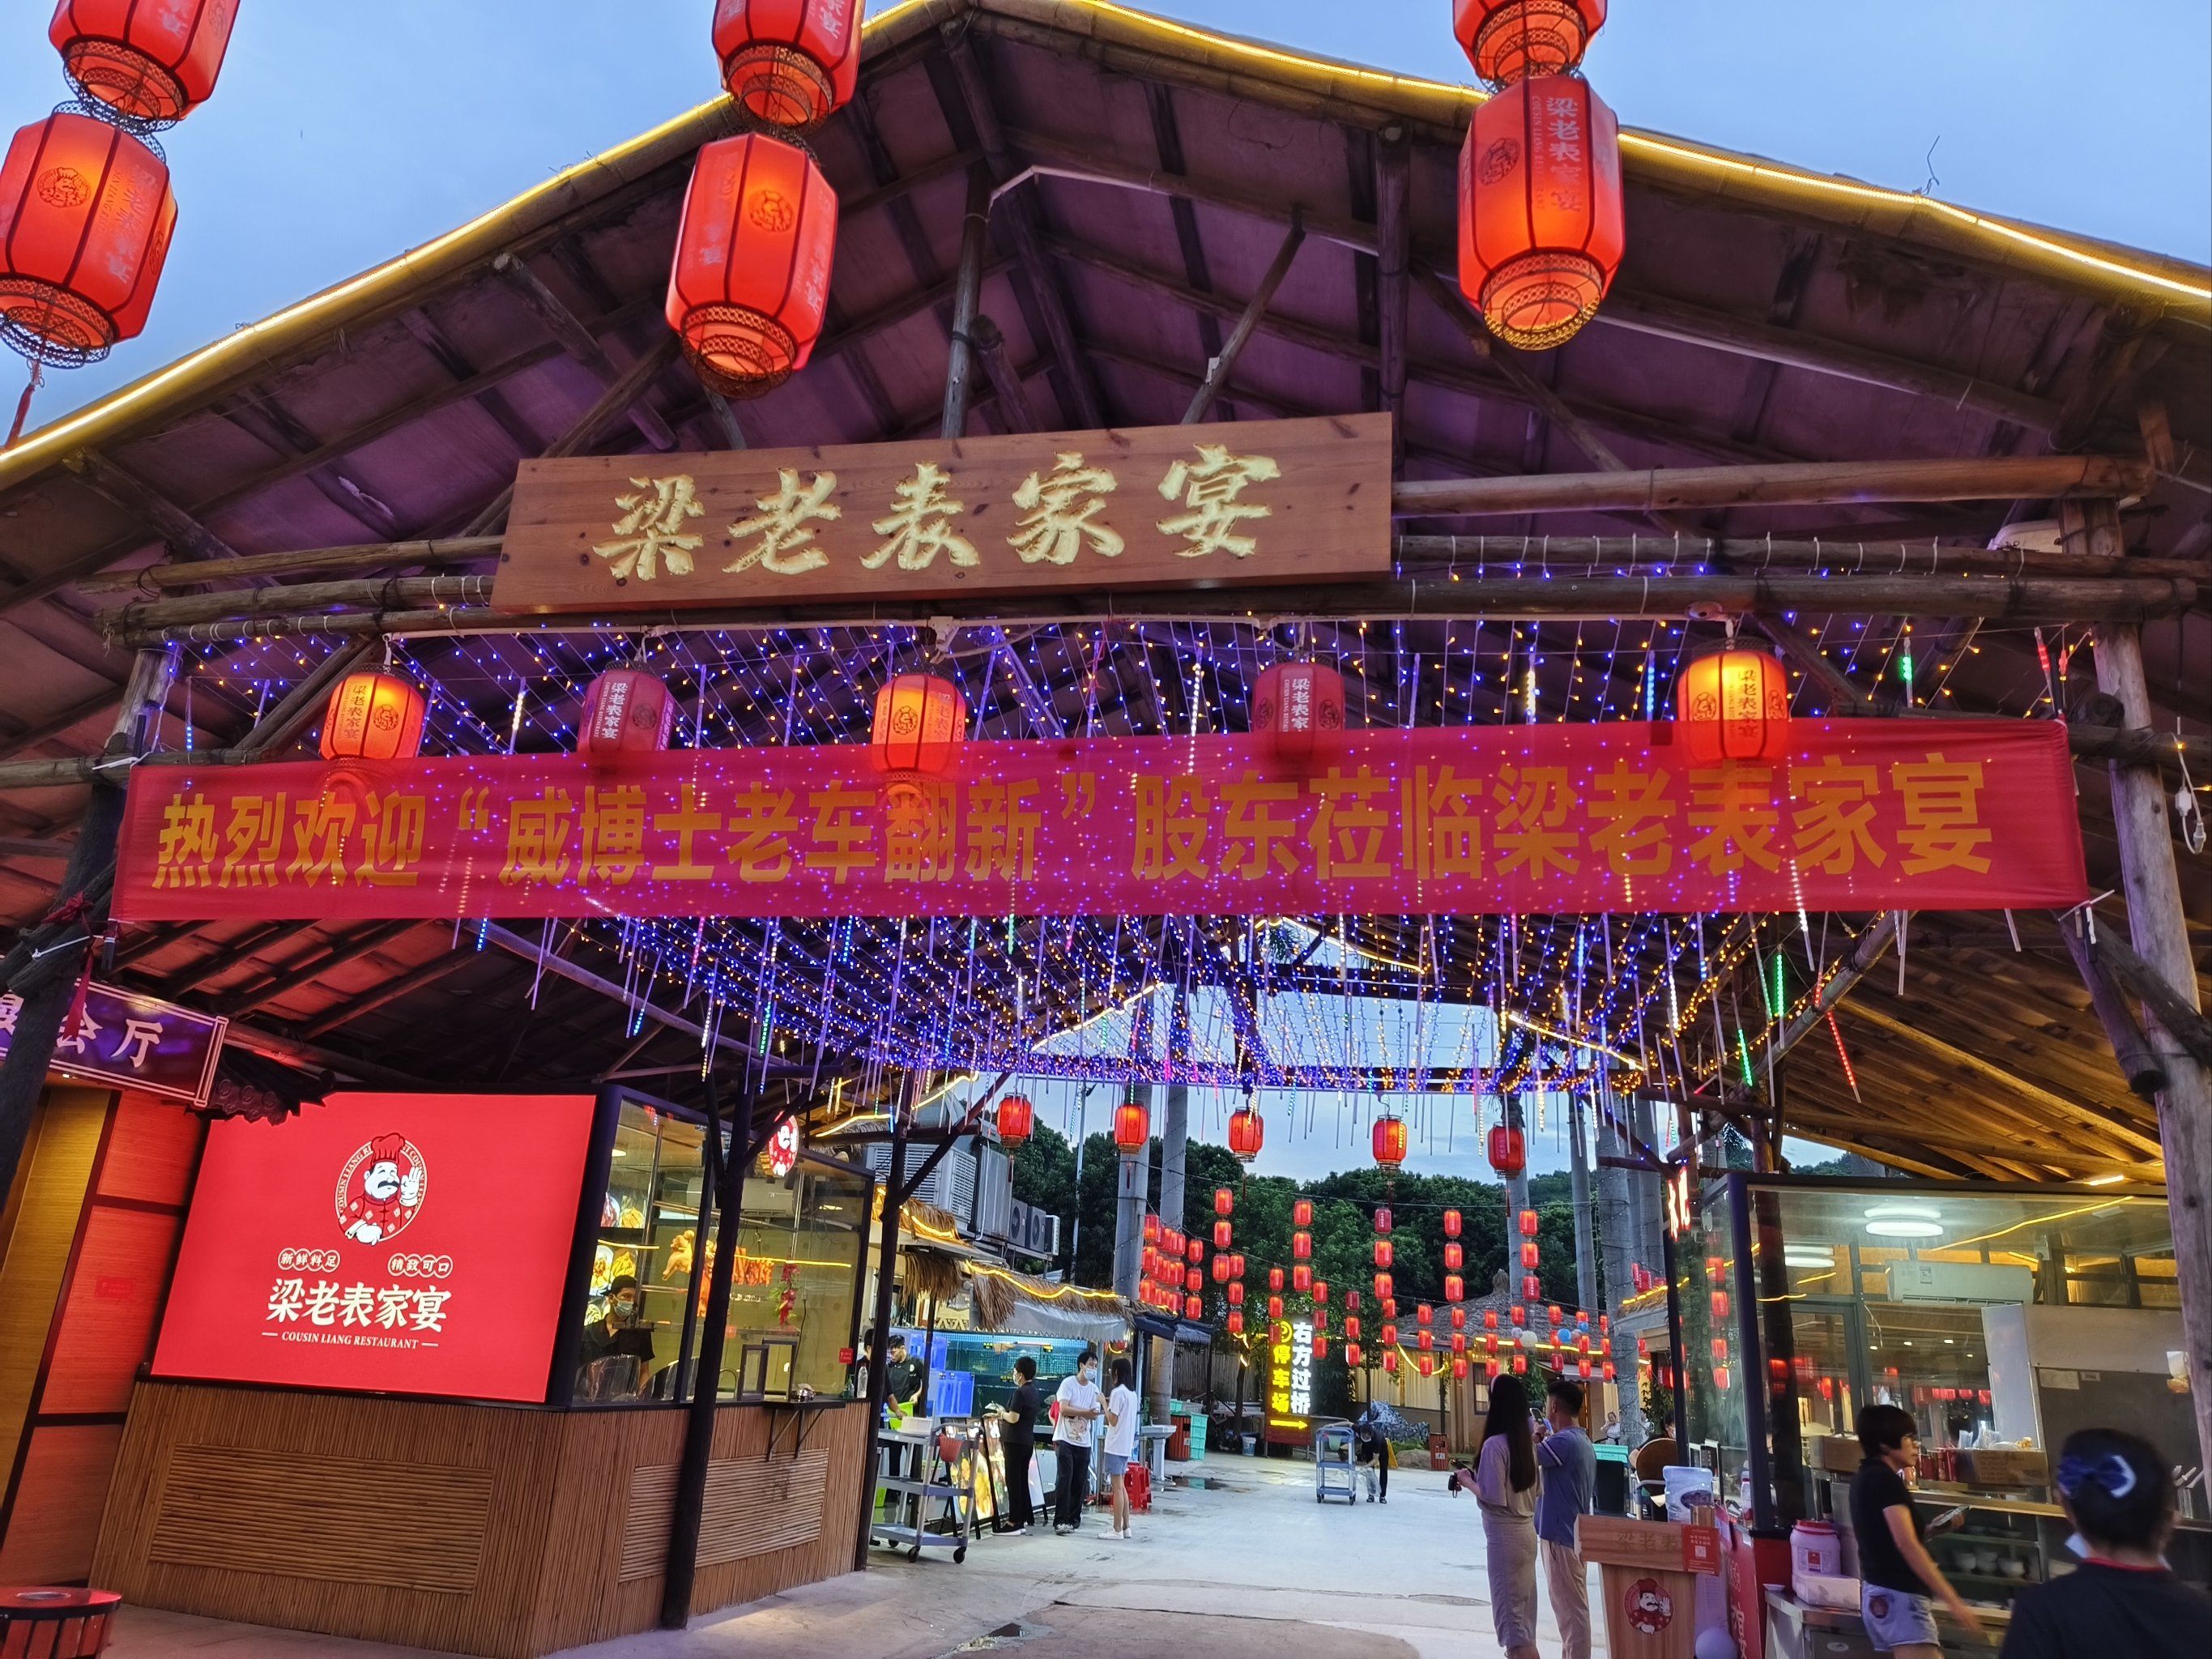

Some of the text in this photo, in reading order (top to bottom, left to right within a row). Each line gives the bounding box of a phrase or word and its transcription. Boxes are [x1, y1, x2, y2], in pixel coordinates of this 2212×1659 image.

[592, 443, 1281, 581] 梁老表家宴
[602, 682, 628, 739] 梁老表家宴
[280, 1252, 338, 1269] 新鲜料足
[390, 1258, 451, 1273] 精致可口
[266, 1277, 452, 1333] 梁老表家宴
[282, 1331, 420, 1349] COUSIN LIANG RESTAURANT
[1290, 1321, 1313, 1414] 右方过桥
[1271, 1344, 1291, 1414] 停车场
